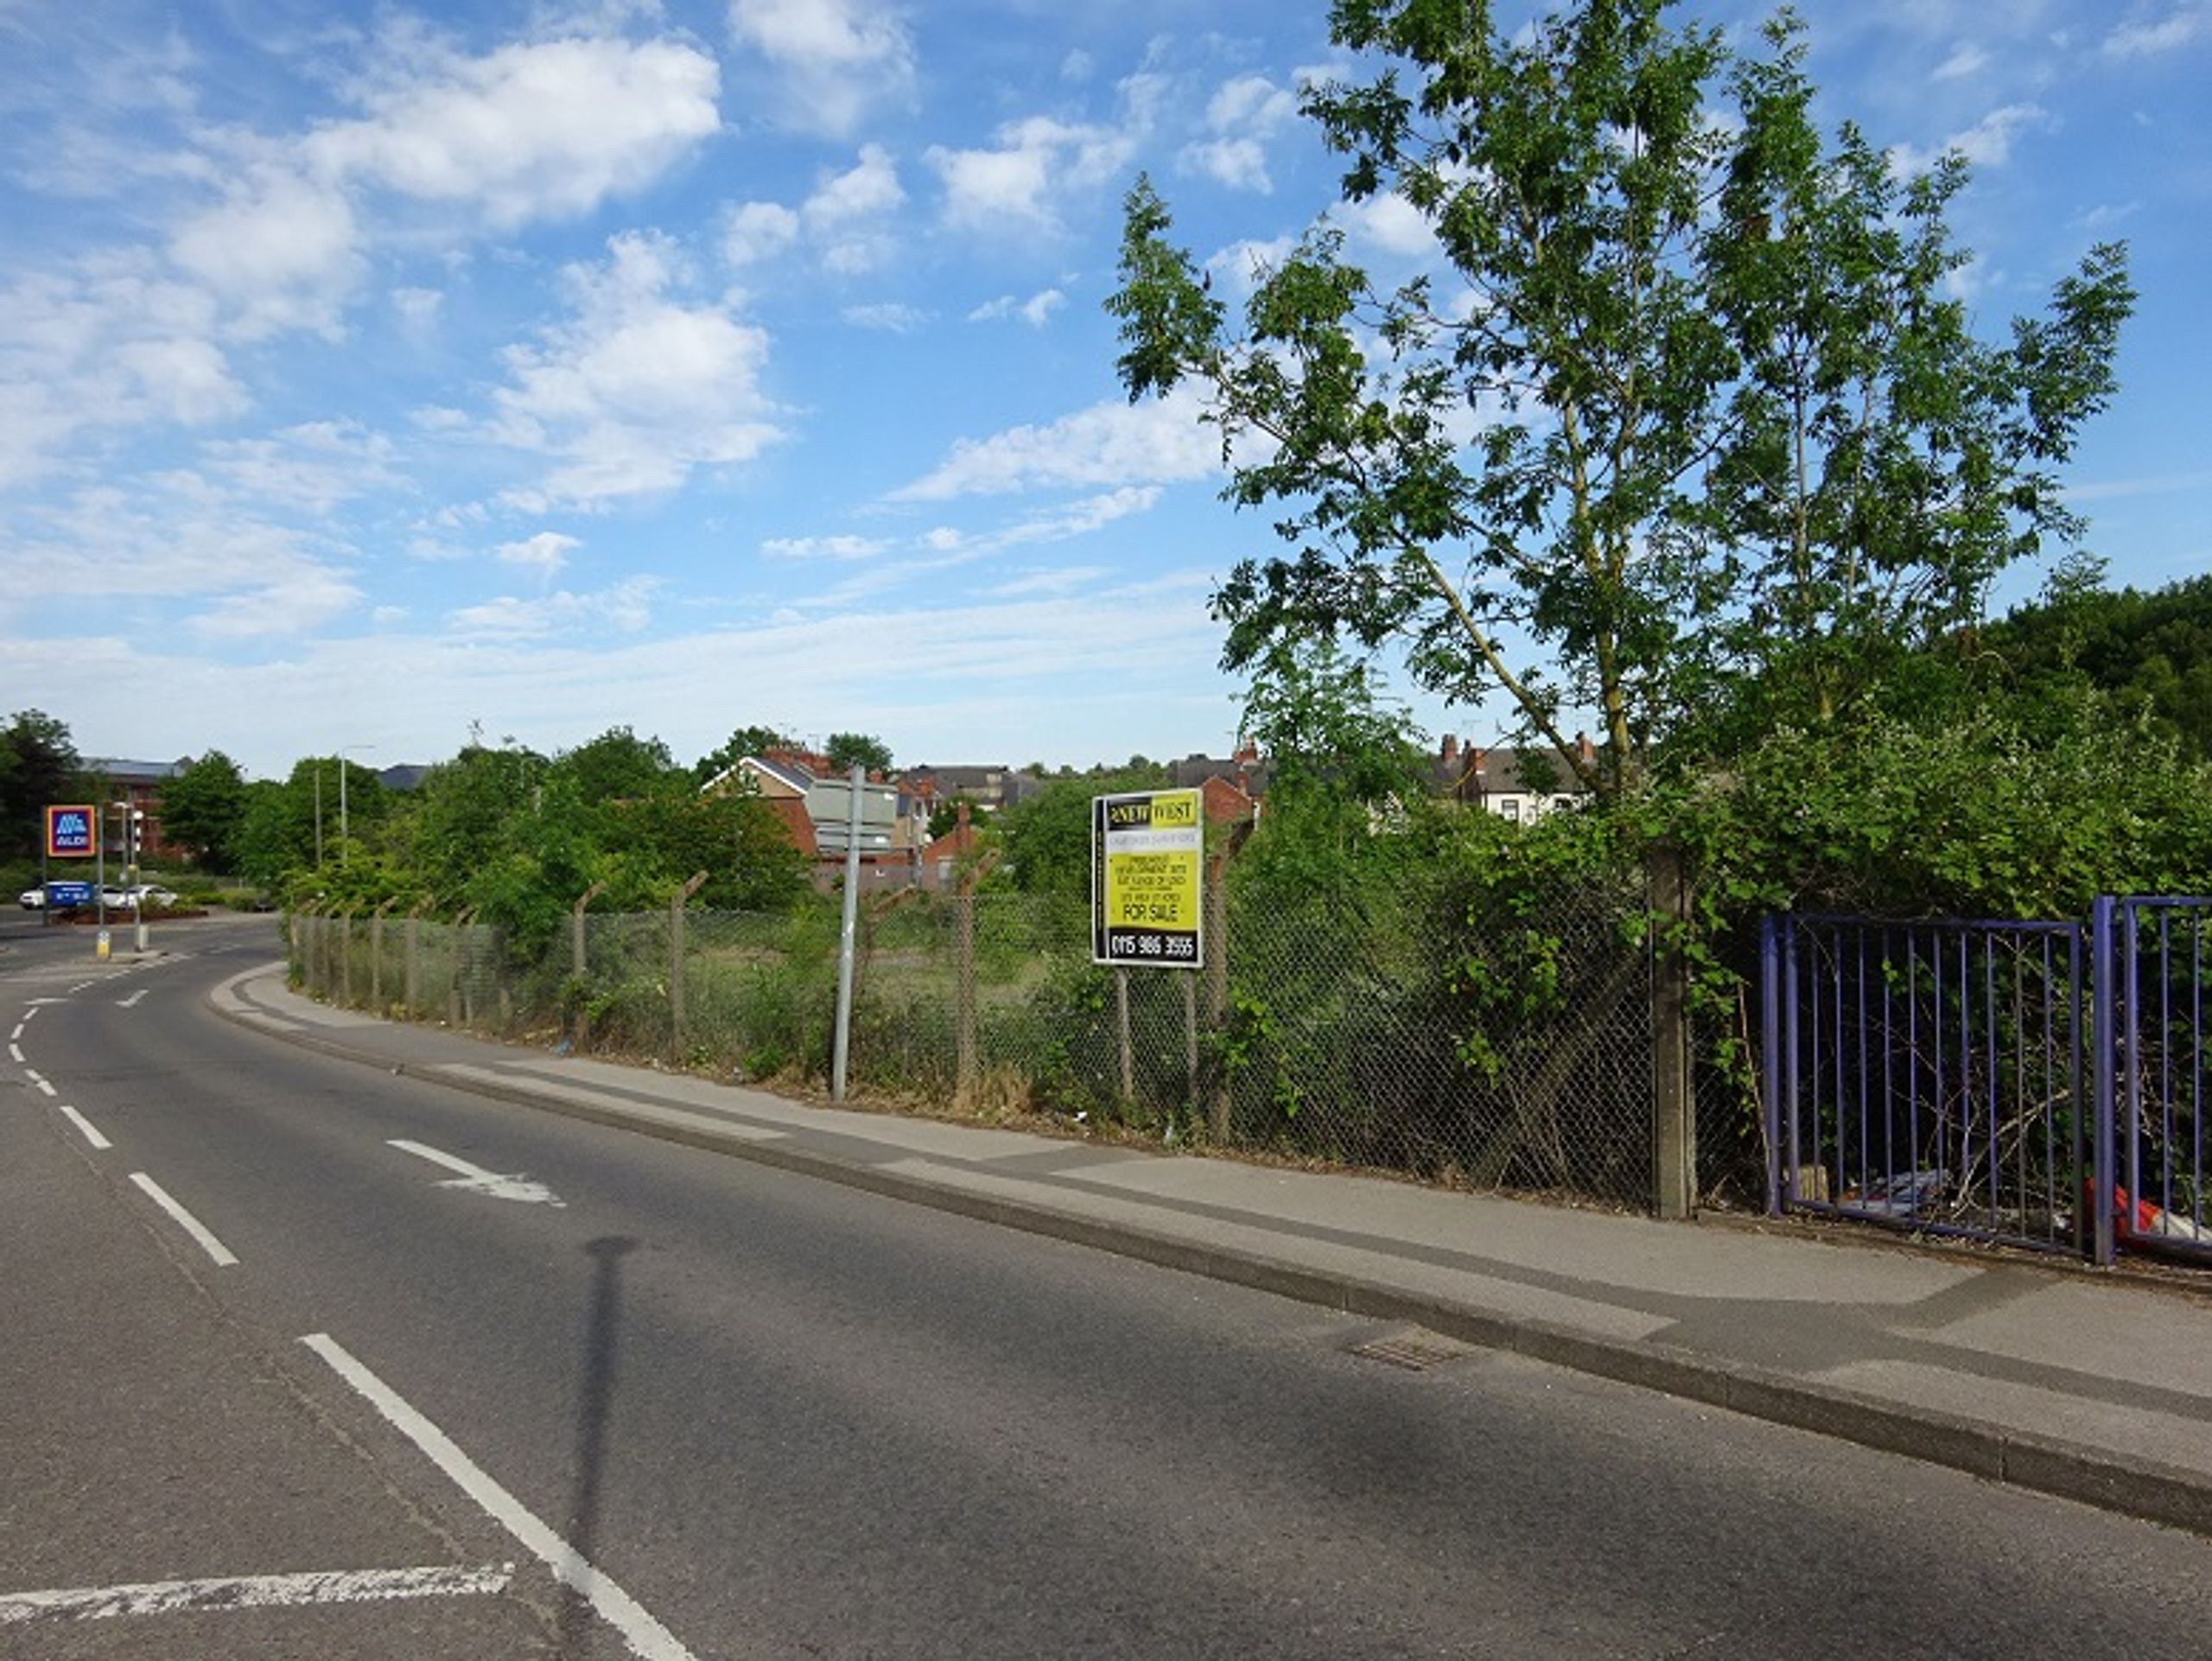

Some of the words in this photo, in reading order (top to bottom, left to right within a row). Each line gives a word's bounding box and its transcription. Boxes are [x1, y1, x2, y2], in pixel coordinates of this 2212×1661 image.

[1154, 802, 1192, 822] WEST
[57, 836, 87, 846] ALDI
[1123, 904, 1147, 921] FOR
[1149, 904, 1178, 922] SALE
